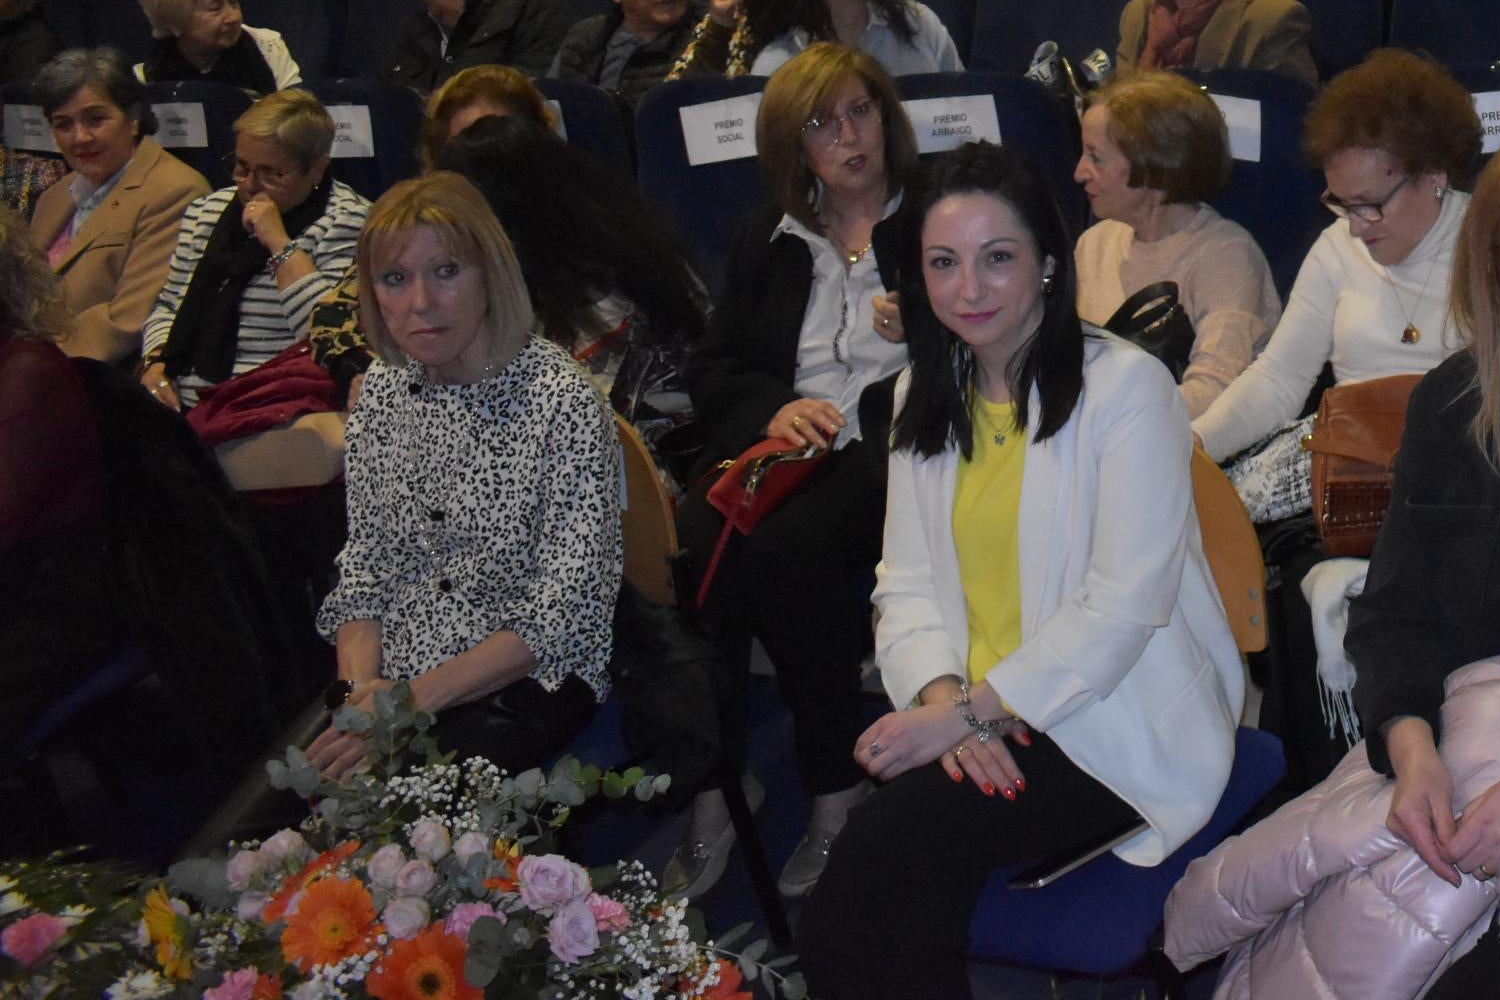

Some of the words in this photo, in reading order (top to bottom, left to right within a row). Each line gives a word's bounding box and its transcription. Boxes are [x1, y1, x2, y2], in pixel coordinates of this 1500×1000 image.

[714, 118, 744, 129] PREMIO
[934, 113, 968, 124] PREMIO
[931, 126, 972, 137] ARRAIGO
[717, 132, 744, 144] SOCIAL
